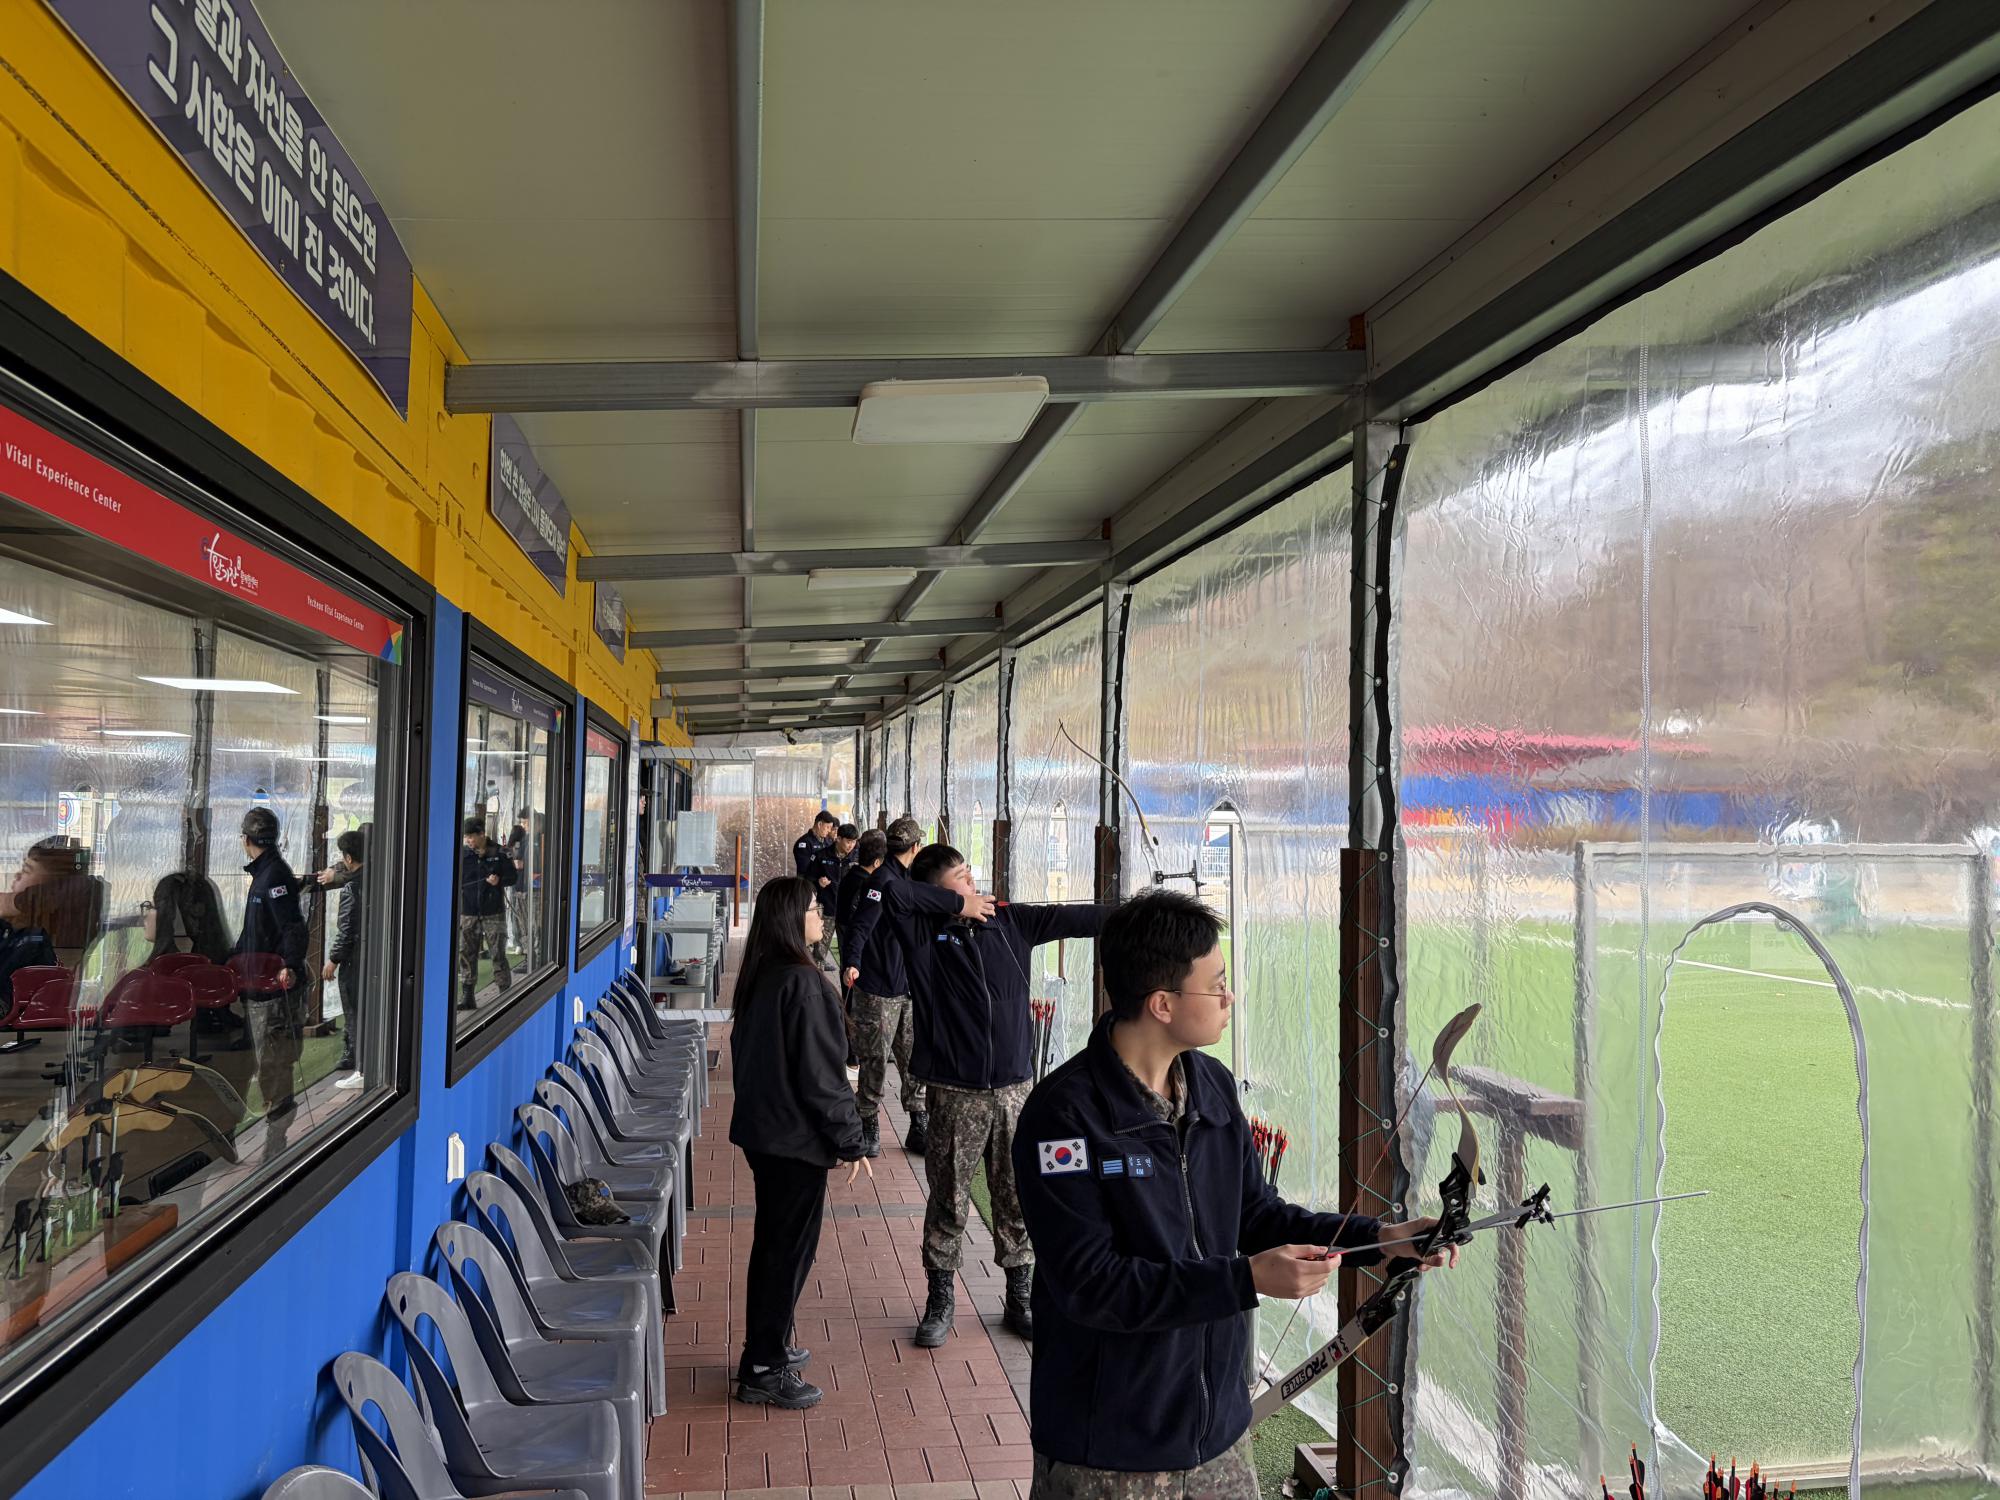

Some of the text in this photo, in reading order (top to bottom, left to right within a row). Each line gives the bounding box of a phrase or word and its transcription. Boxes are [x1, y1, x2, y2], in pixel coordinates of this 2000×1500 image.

[149, 3, 376, 346] 그 시합은 이미 진 것이다.
[245, 38, 303, 178] 자신을
[309, 138, 328, 208] 안
[332, 167, 376, 275] 믿으면
[5, 442, 32, 470] Vital
[36, 458, 90, 498] Experience
[92, 487, 122, 513] Center
[334, 608, 353, 626] Experience
[353, 618, 365, 631] Center
